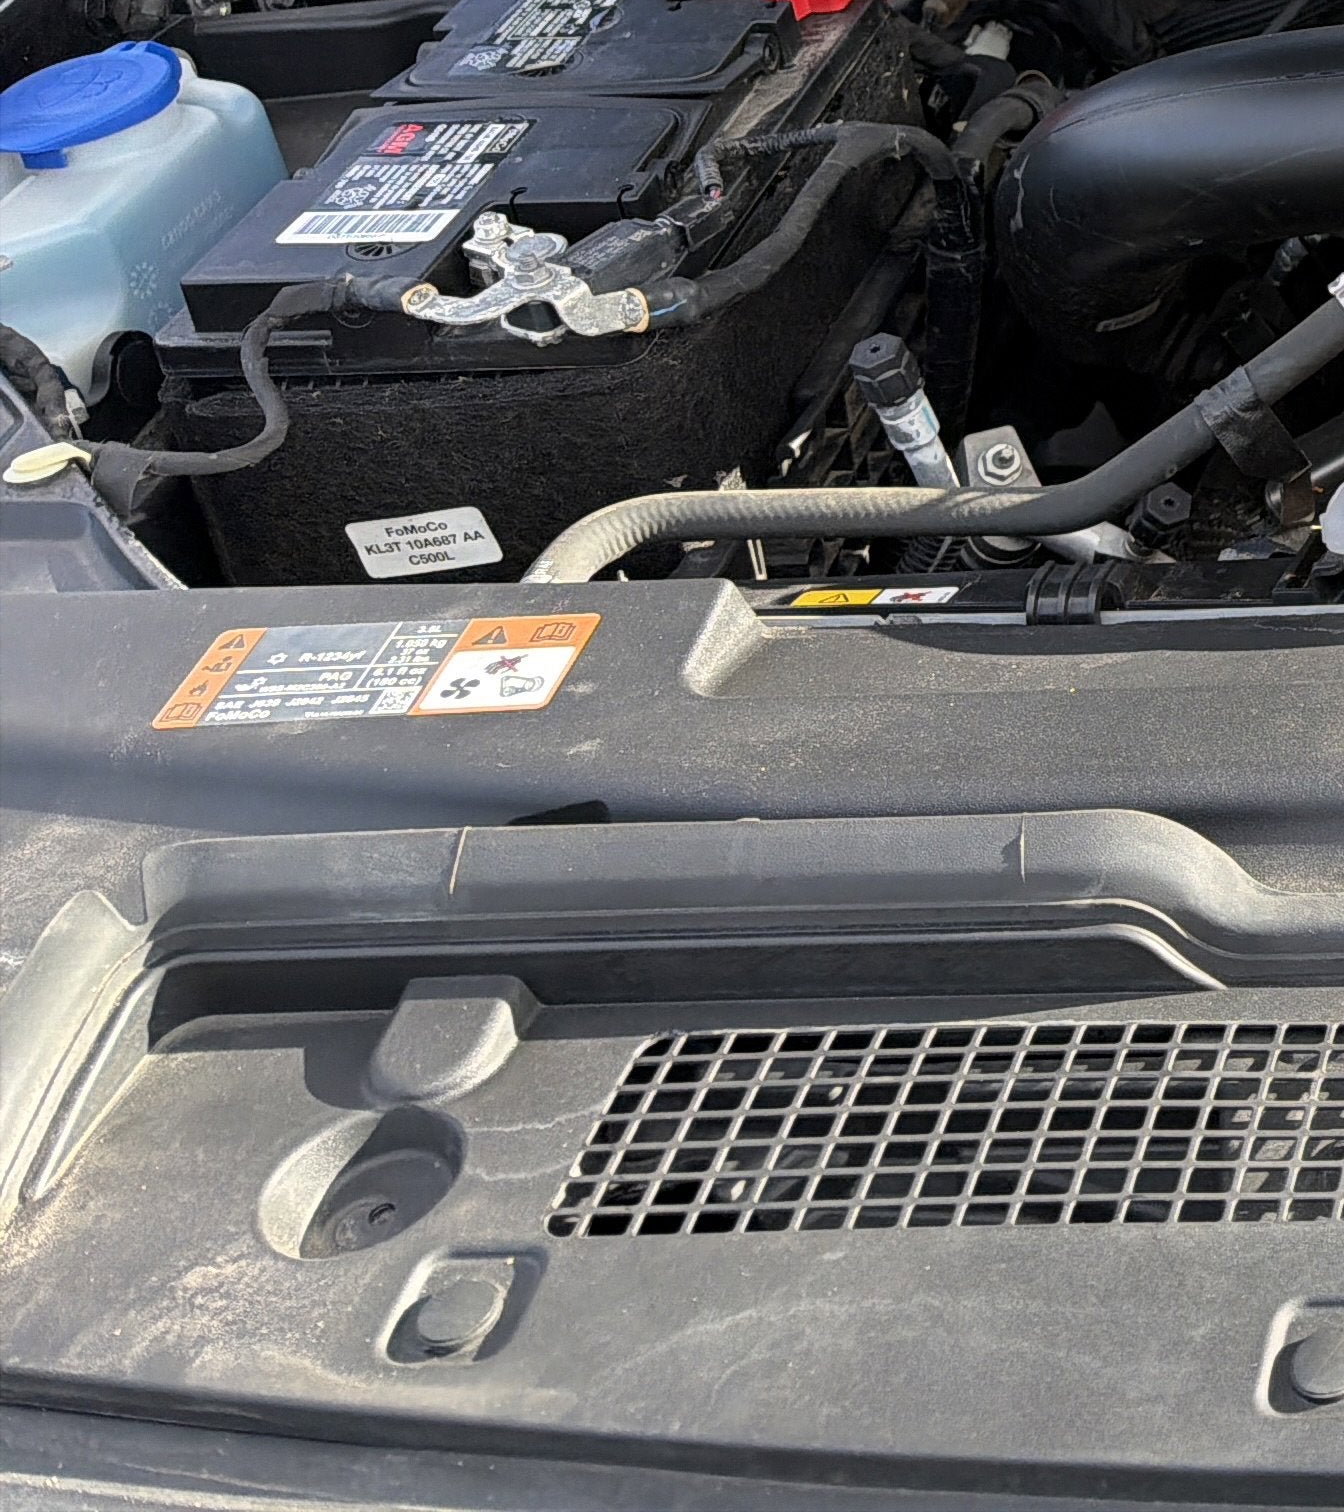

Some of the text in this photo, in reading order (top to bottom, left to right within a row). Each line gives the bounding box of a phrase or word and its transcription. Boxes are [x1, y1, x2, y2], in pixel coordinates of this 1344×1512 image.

[383, 123, 424, 154] AGM
[384, 521, 448, 538] FoMoCo
[364, 541, 401, 556] KL3T
[463, 530, 485, 543] AA
[408, 550, 456, 566] C500L
[298, 649, 367, 663] R-1234yf
[214, 700, 246, 710] SAE
[204, 708, 272, 722] FoMoCo
